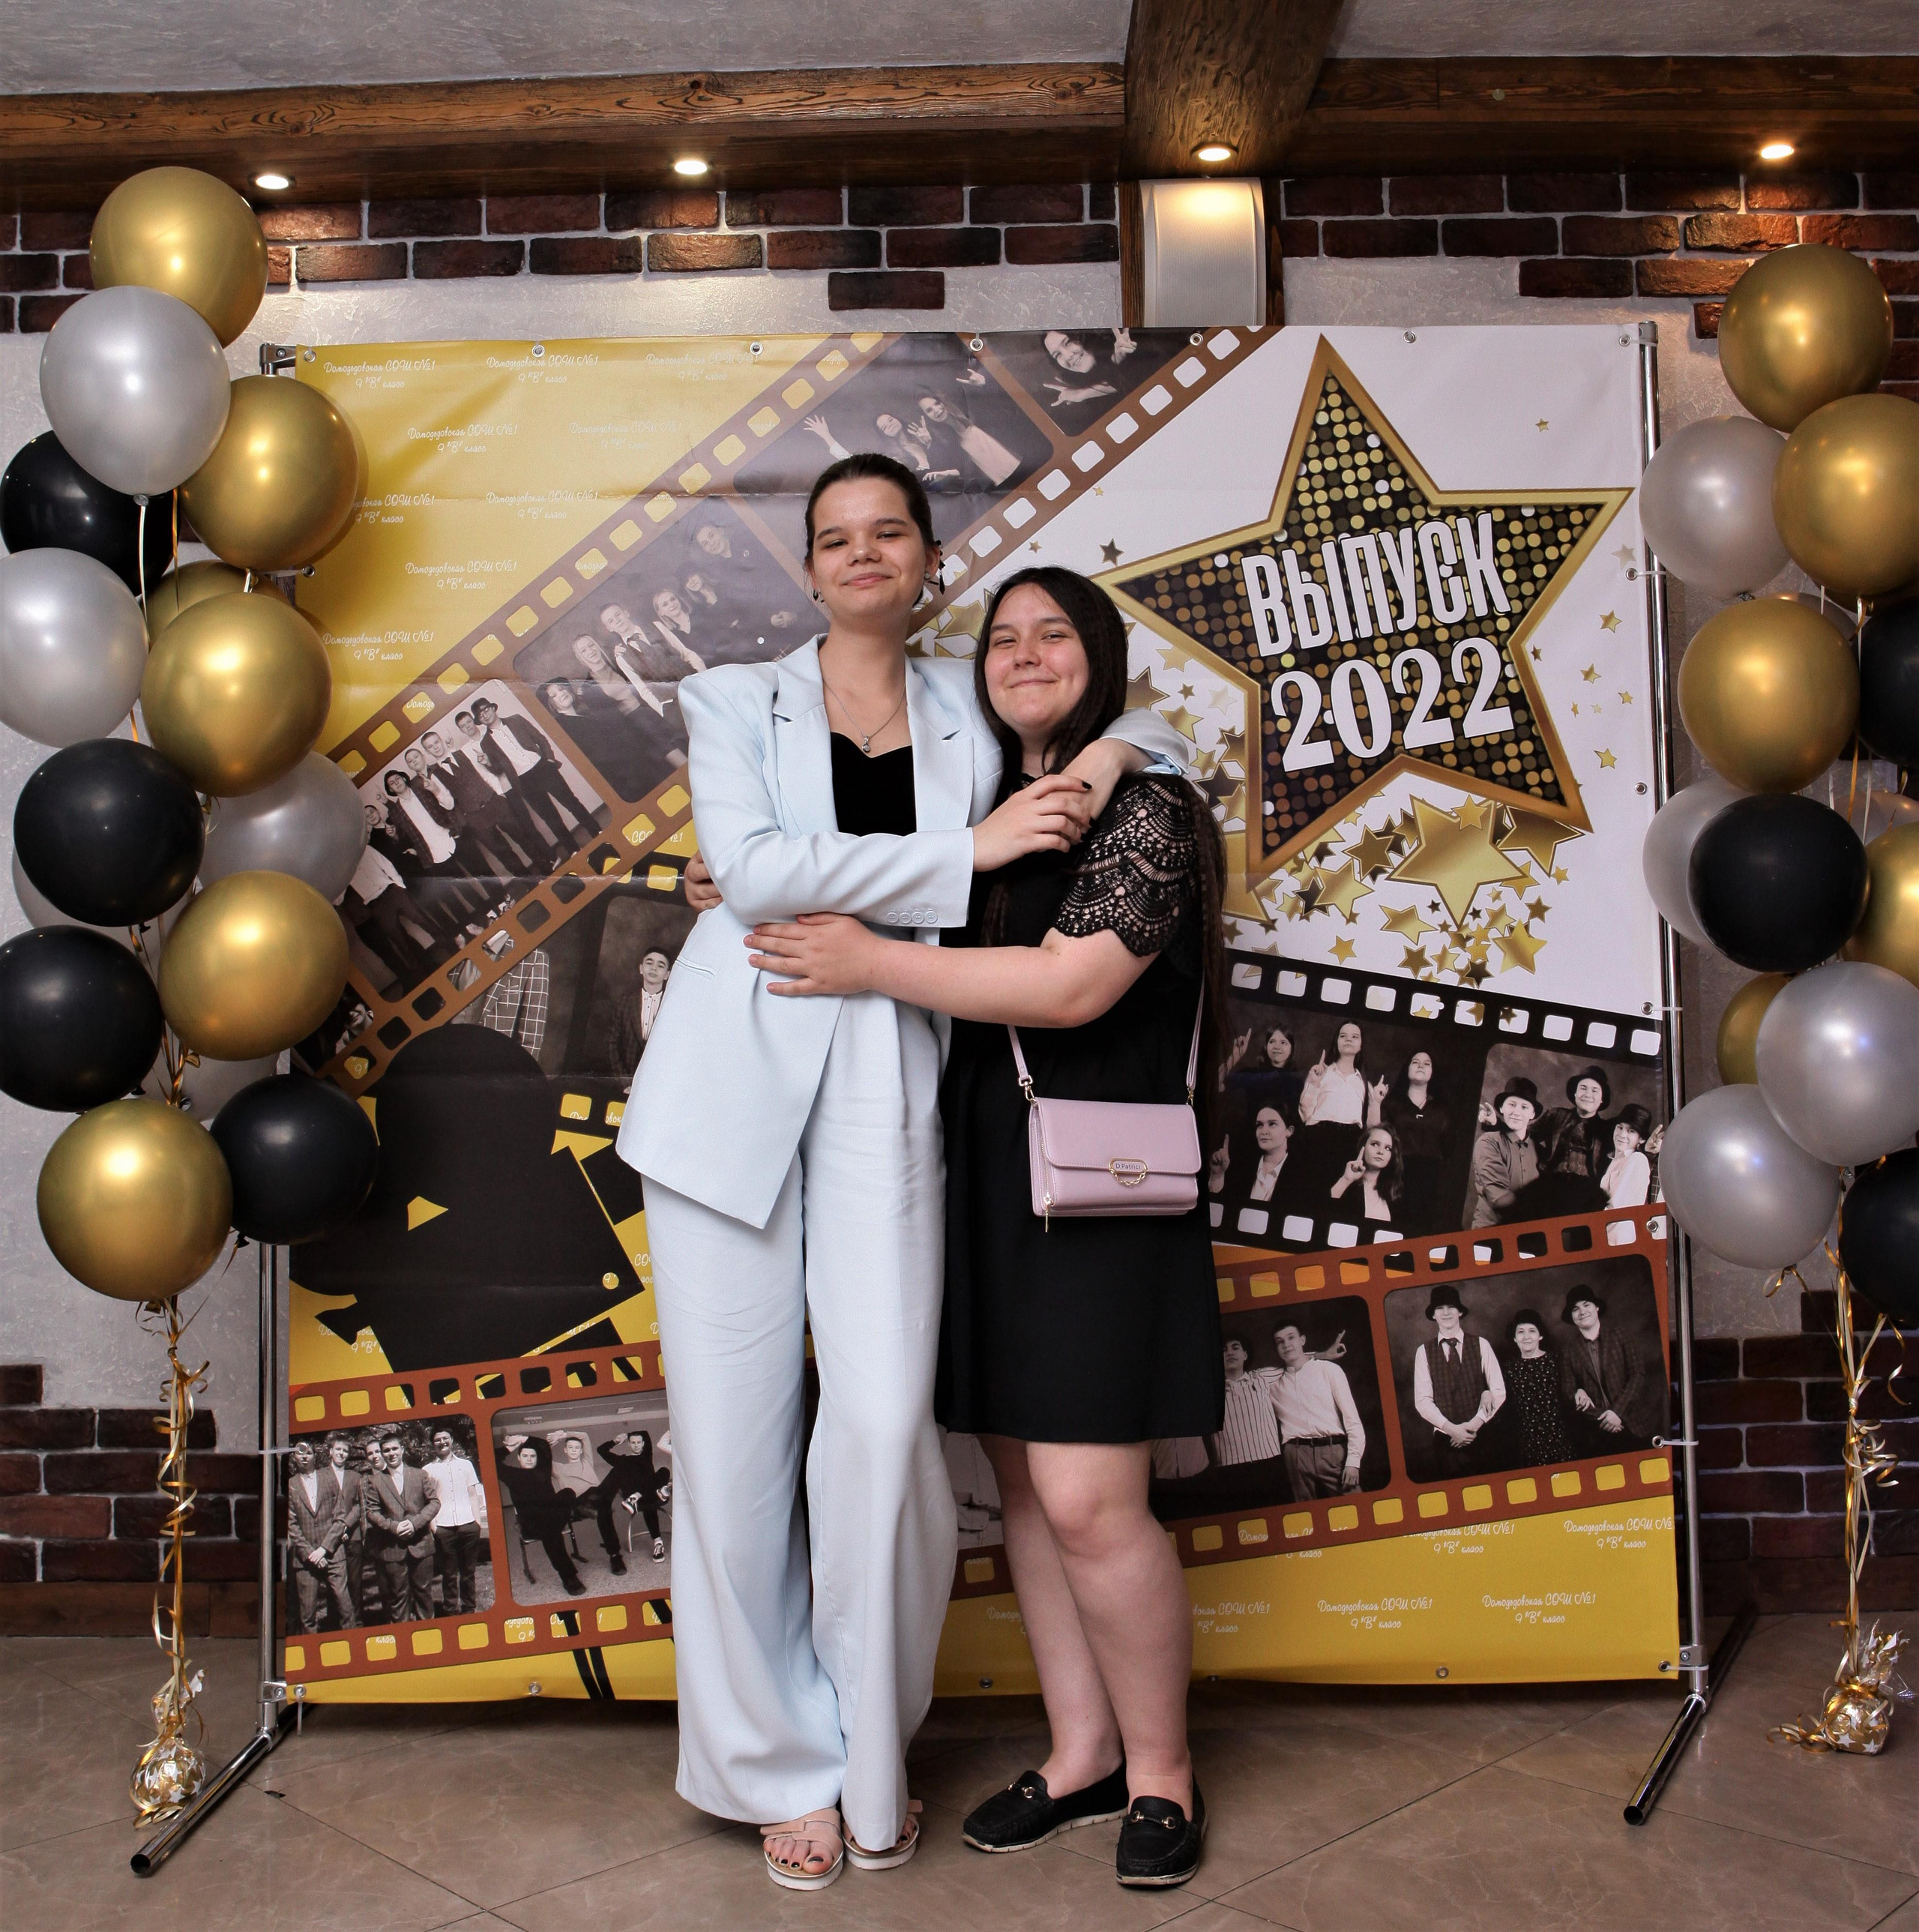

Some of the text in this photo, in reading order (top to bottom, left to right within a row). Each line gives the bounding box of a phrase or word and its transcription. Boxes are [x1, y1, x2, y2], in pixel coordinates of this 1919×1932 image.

[385, 360, 412, 372] СОШ
[548, 355, 574, 367] СОШ
[467, 424, 495, 436] СОШ
[385, 493, 412, 507] СОШ
[548, 490, 574, 503] СОШ
[467, 560, 494, 574] СОШ
[1240, 512, 1512, 657] ВЫПУСК
[384, 631, 411, 644] СОШ
[1271, 637, 1514, 772] 2022
[634, 1254, 651, 1266] СО
[1463, 1523, 1491, 1535] СОШ
[1626, 1517, 1653, 1531] СОШ
[1381, 1598, 1409, 1611] СОШ
[1545, 1592, 1573, 1606] СОШ
